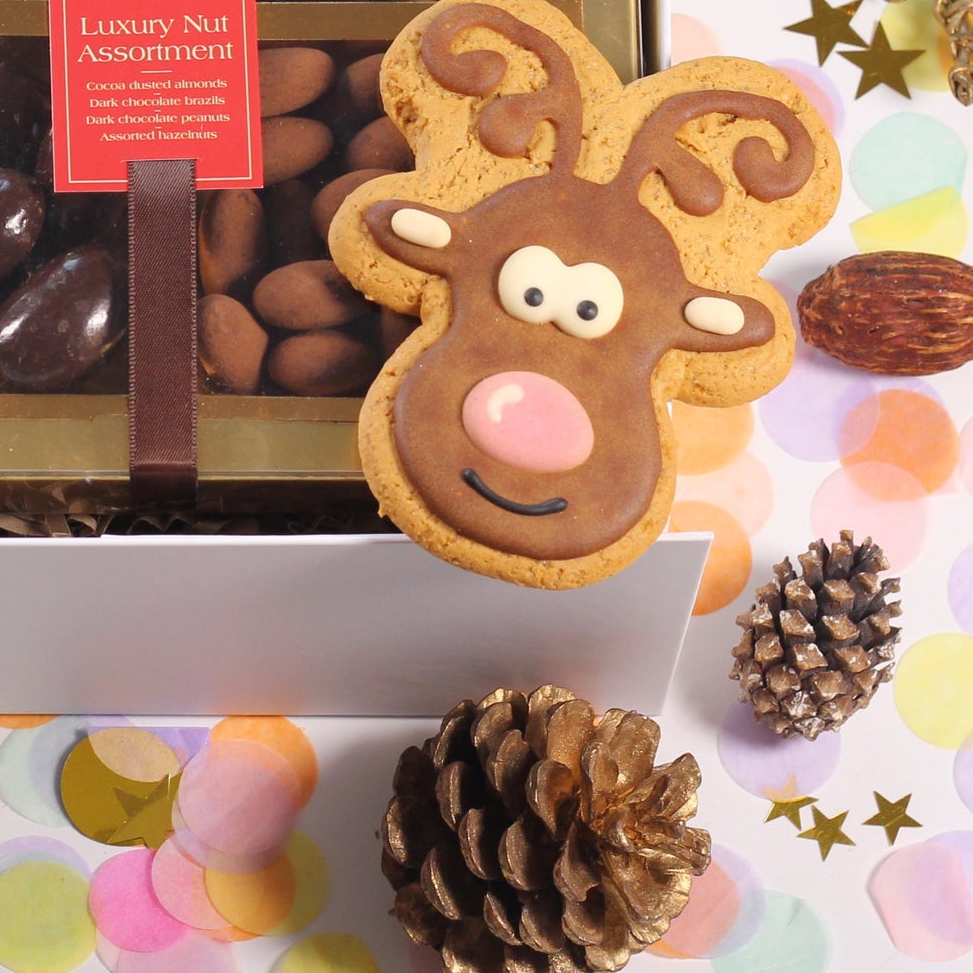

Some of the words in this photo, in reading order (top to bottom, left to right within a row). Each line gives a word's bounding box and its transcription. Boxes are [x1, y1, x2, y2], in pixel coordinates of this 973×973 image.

[81, 16, 175, 38] Luxury
[183, 15, 228, 34] Nut
[77, 42, 233, 63] Assortment
[86, 81, 126, 91] Cocoa
[129, 80, 172, 90] dusted
[175, 78, 228, 90] almonds
[90, 97, 118, 108] Dark
[122, 96, 181, 107] chocolate
[185, 95, 225, 106] brazils
[86, 114, 115, 125] Dark
[118, 113, 178, 124] chocolate
[181, 112, 231, 125] peanuts
[100, 131, 155, 142] Assorted
[158, 130, 218, 140] hazelnuts
